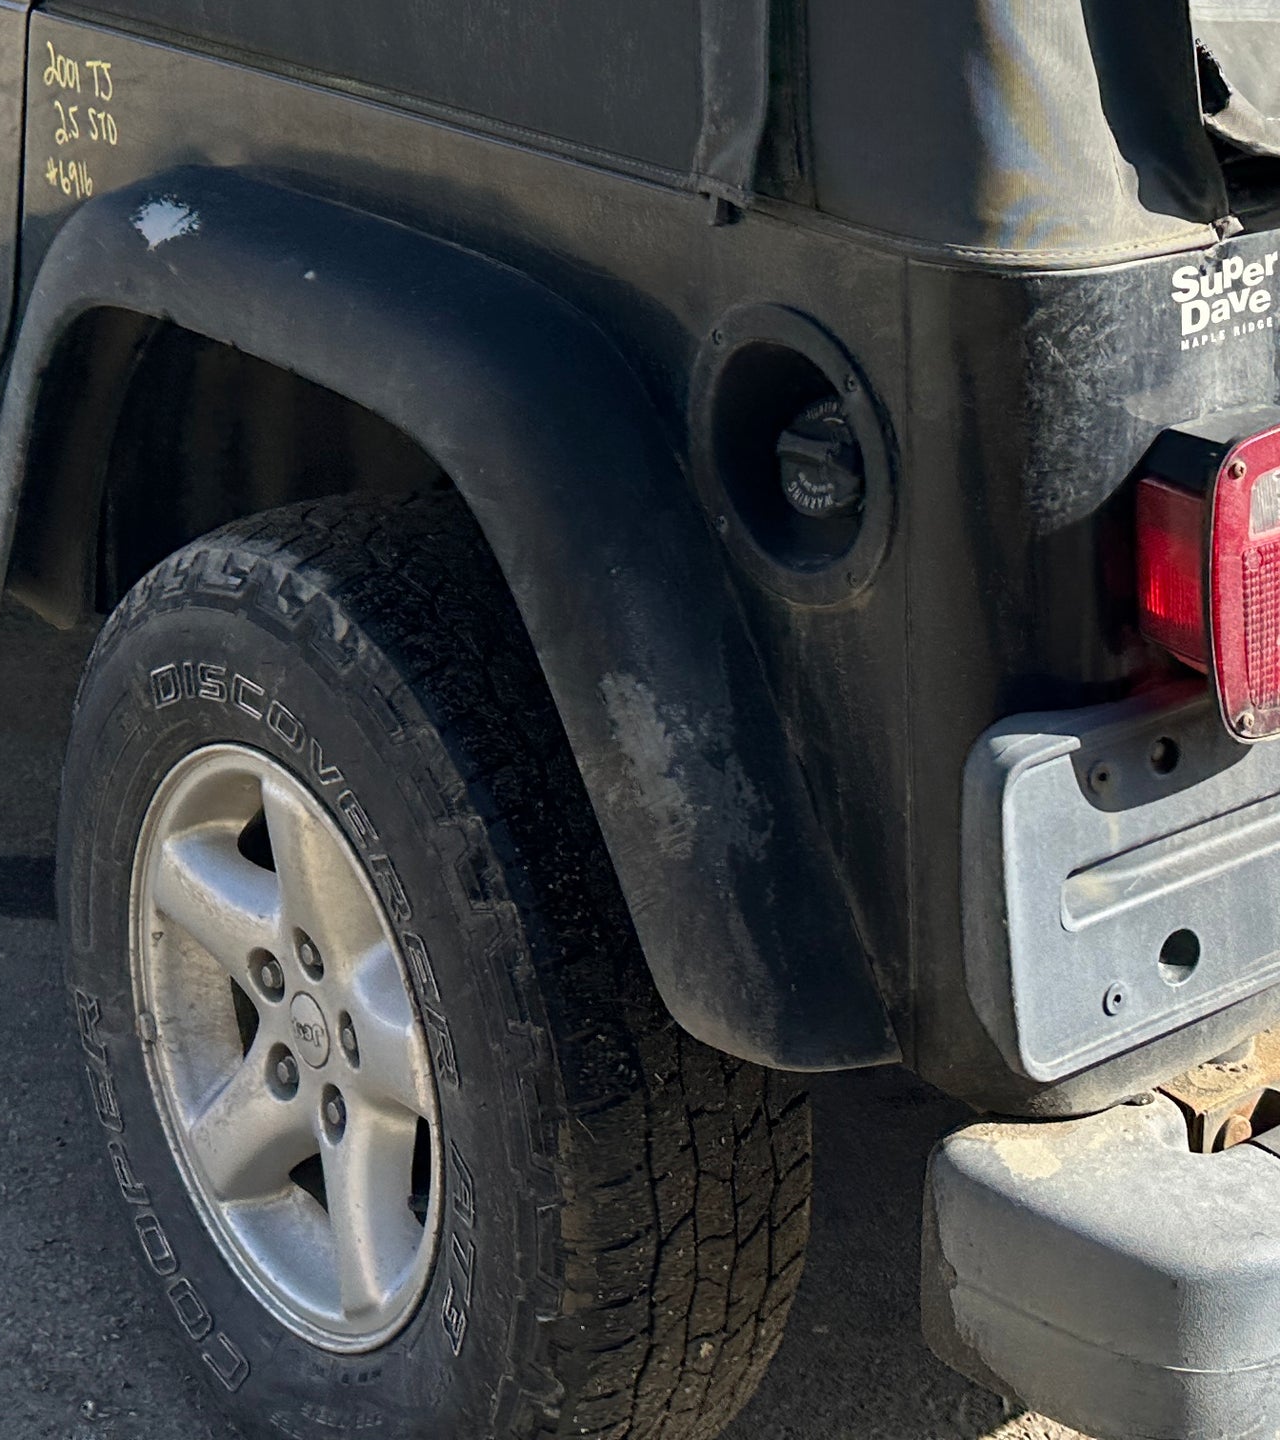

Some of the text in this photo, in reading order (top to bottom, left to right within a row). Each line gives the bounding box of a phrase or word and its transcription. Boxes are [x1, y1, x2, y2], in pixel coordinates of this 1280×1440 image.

[43, 40, 114, 101] 2001 TJ
[87, 107, 118, 146] STD
[1171, 250, 1279, 303] Super
[1180, 316, 1274, 351] MAPLE RIDGE
[1181, 286, 1272, 337] Dave
[787, 479, 835, 510] WARNING
[149, 661, 461, 1091] DISCOVERER
[74, 988, 251, 1392] COOPER
